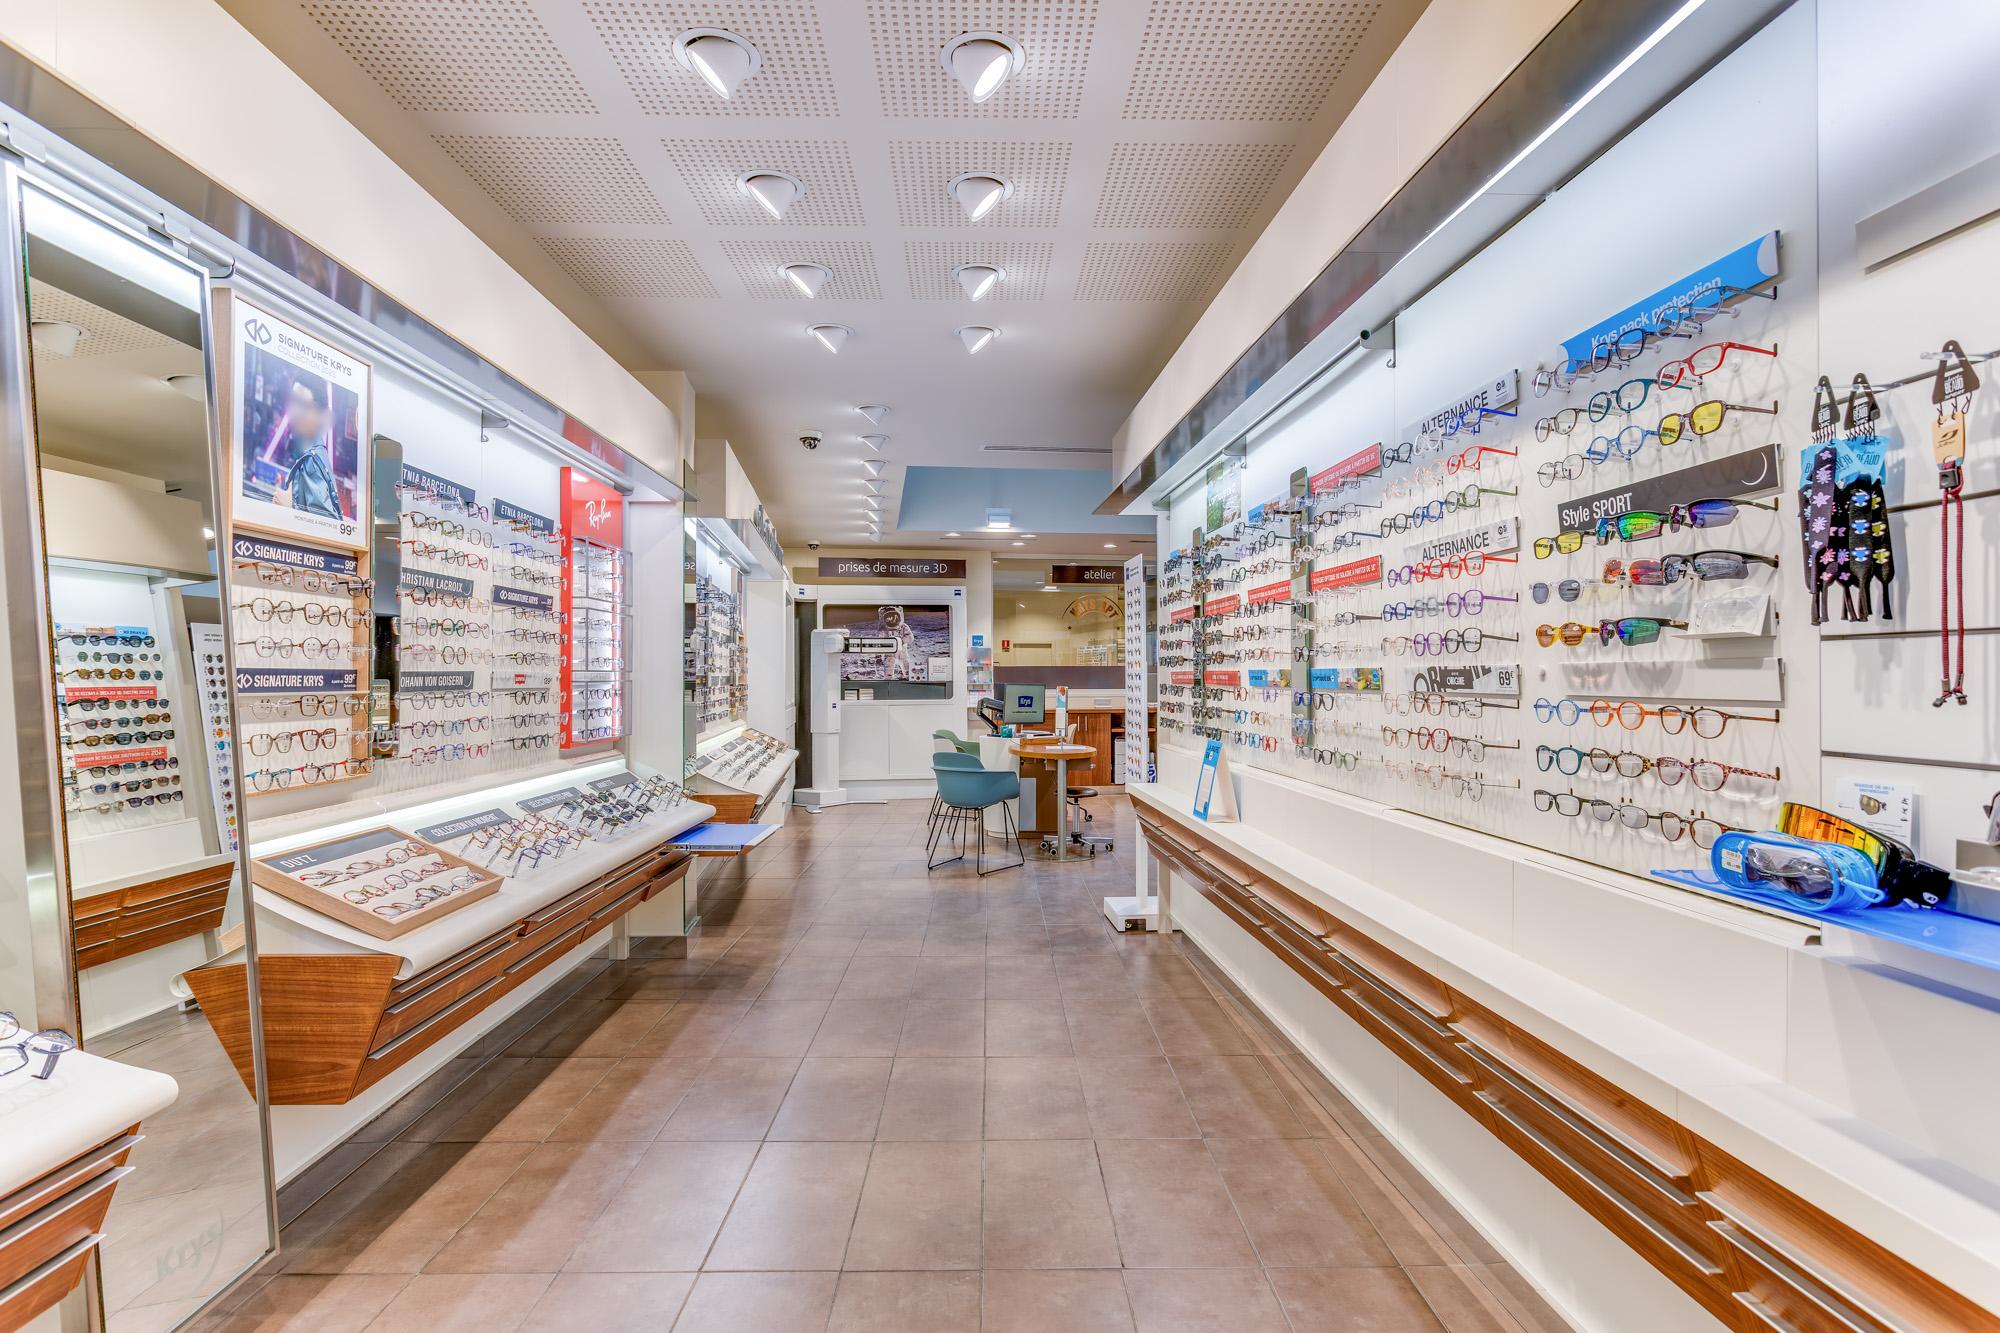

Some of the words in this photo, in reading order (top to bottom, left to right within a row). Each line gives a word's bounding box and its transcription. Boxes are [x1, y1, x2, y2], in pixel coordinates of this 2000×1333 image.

[1591, 328, 1617, 350] Krys
[1619, 310, 1650, 339] pack
[1651, 276, 1722, 326] protection
[278, 333, 329, 366] SIGNATURE
[330, 358, 352, 377] KRYS
[1421, 390, 1489, 435] ALTERNANCE
[402, 468, 420, 485] TNIA
[421, 475, 460, 498] BARCELONA
[501, 504, 516, 518] ETNIA
[517, 510, 544, 528] BARCELONA
[1562, 506, 1590, 528] Style
[1592, 492, 1633, 518] SPORT
[254, 544, 303, 565] SIGNATURE
[303, 553, 325, 569] KRYS
[1422, 531, 1490, 562] ALTERNANCE
[838, 561, 870, 574] prises
[873, 562, 887, 573] de
[889, 563, 930, 574] mesure
[933, 563, 948, 574] 3D
[1084, 569, 1116, 580] atelier
[402, 572, 434, 588] HRISTIAN
[436, 578, 463, 593] LACROIX
[254, 674, 303, 688] SIGNATURE
[303, 674, 324, 687] KRYS
[400, 676, 424, 688] OHANN
[425, 676, 437, 687] VON
[438, 675, 464, 687] GOISERN
[1498, 670, 1514, 687] 69€
[1020, 697, 1032, 706] Krys
[431, 822, 468, 837] COLLECTION
[467, 819, 475, 829] DU
[474, 812, 499, 827] MOMENT
[280, 854, 317, 869] DUTZ
